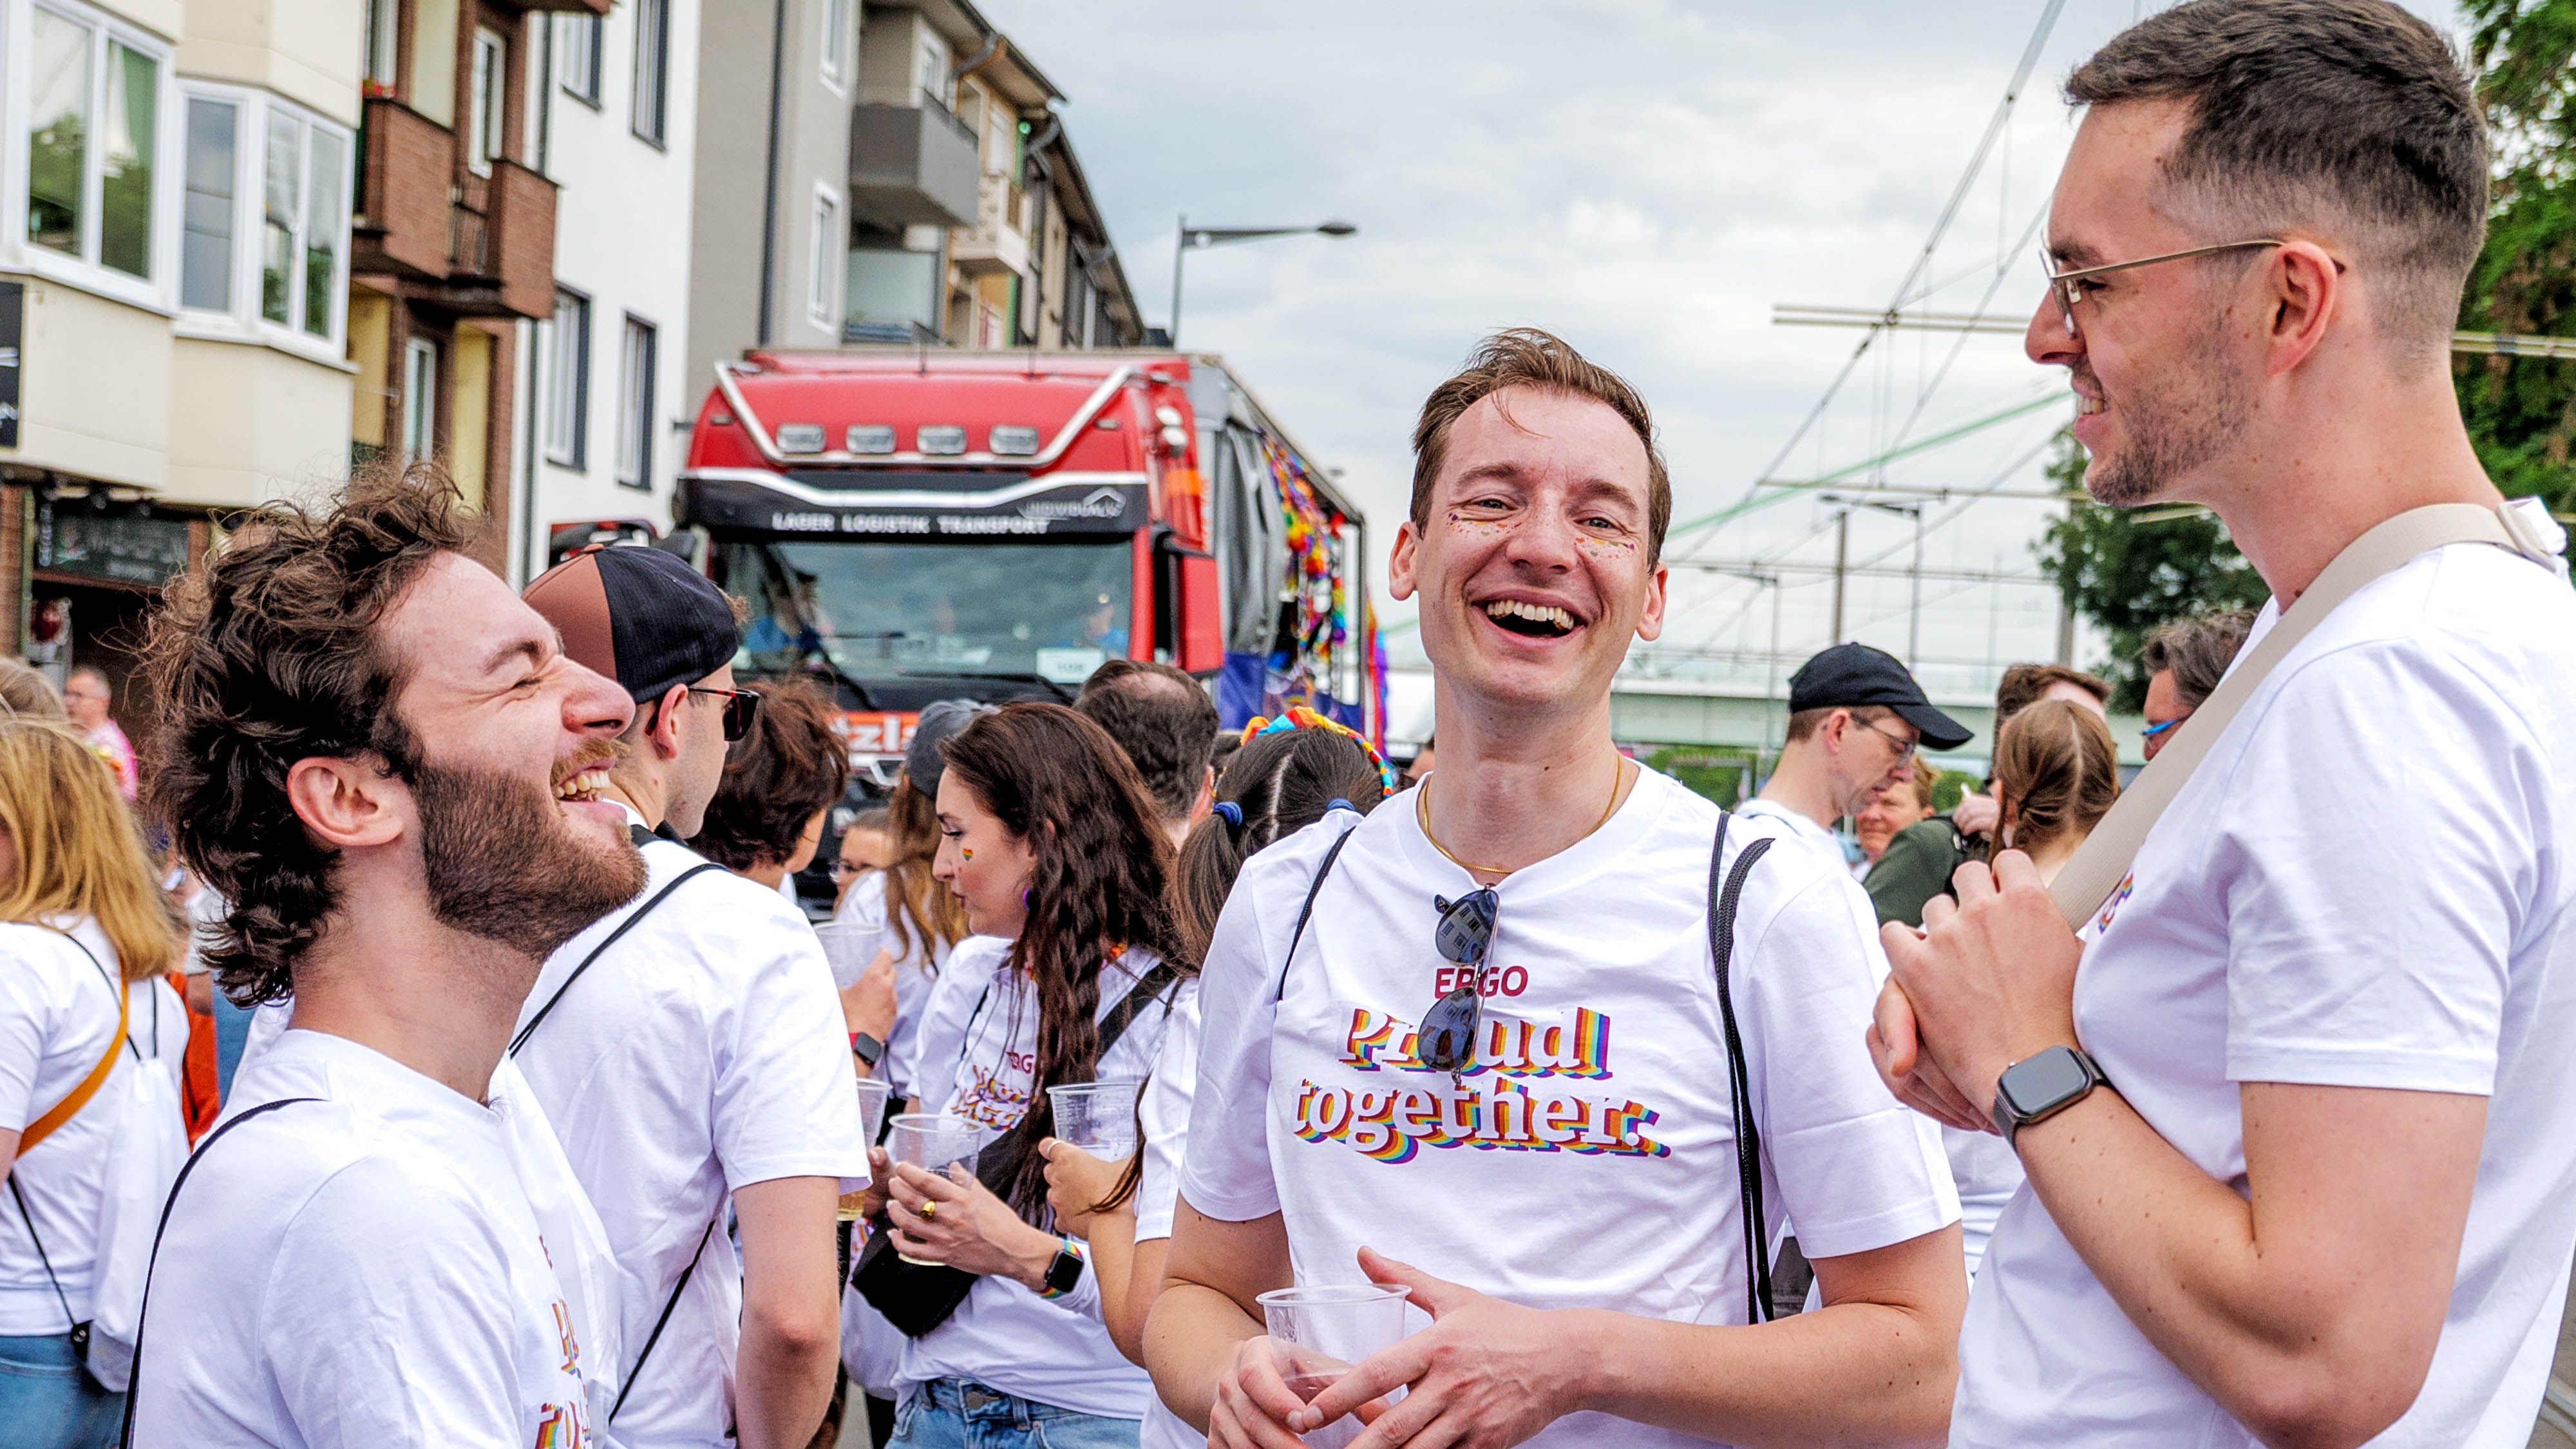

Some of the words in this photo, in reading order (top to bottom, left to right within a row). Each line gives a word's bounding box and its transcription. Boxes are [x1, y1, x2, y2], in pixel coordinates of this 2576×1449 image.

[772, 513, 835, 531] LAGER
[841, 515, 930, 533] LOGISTIK
[938, 516, 1051, 535] TRANSPORT
[1336, 1005, 1613, 1081] Prud
